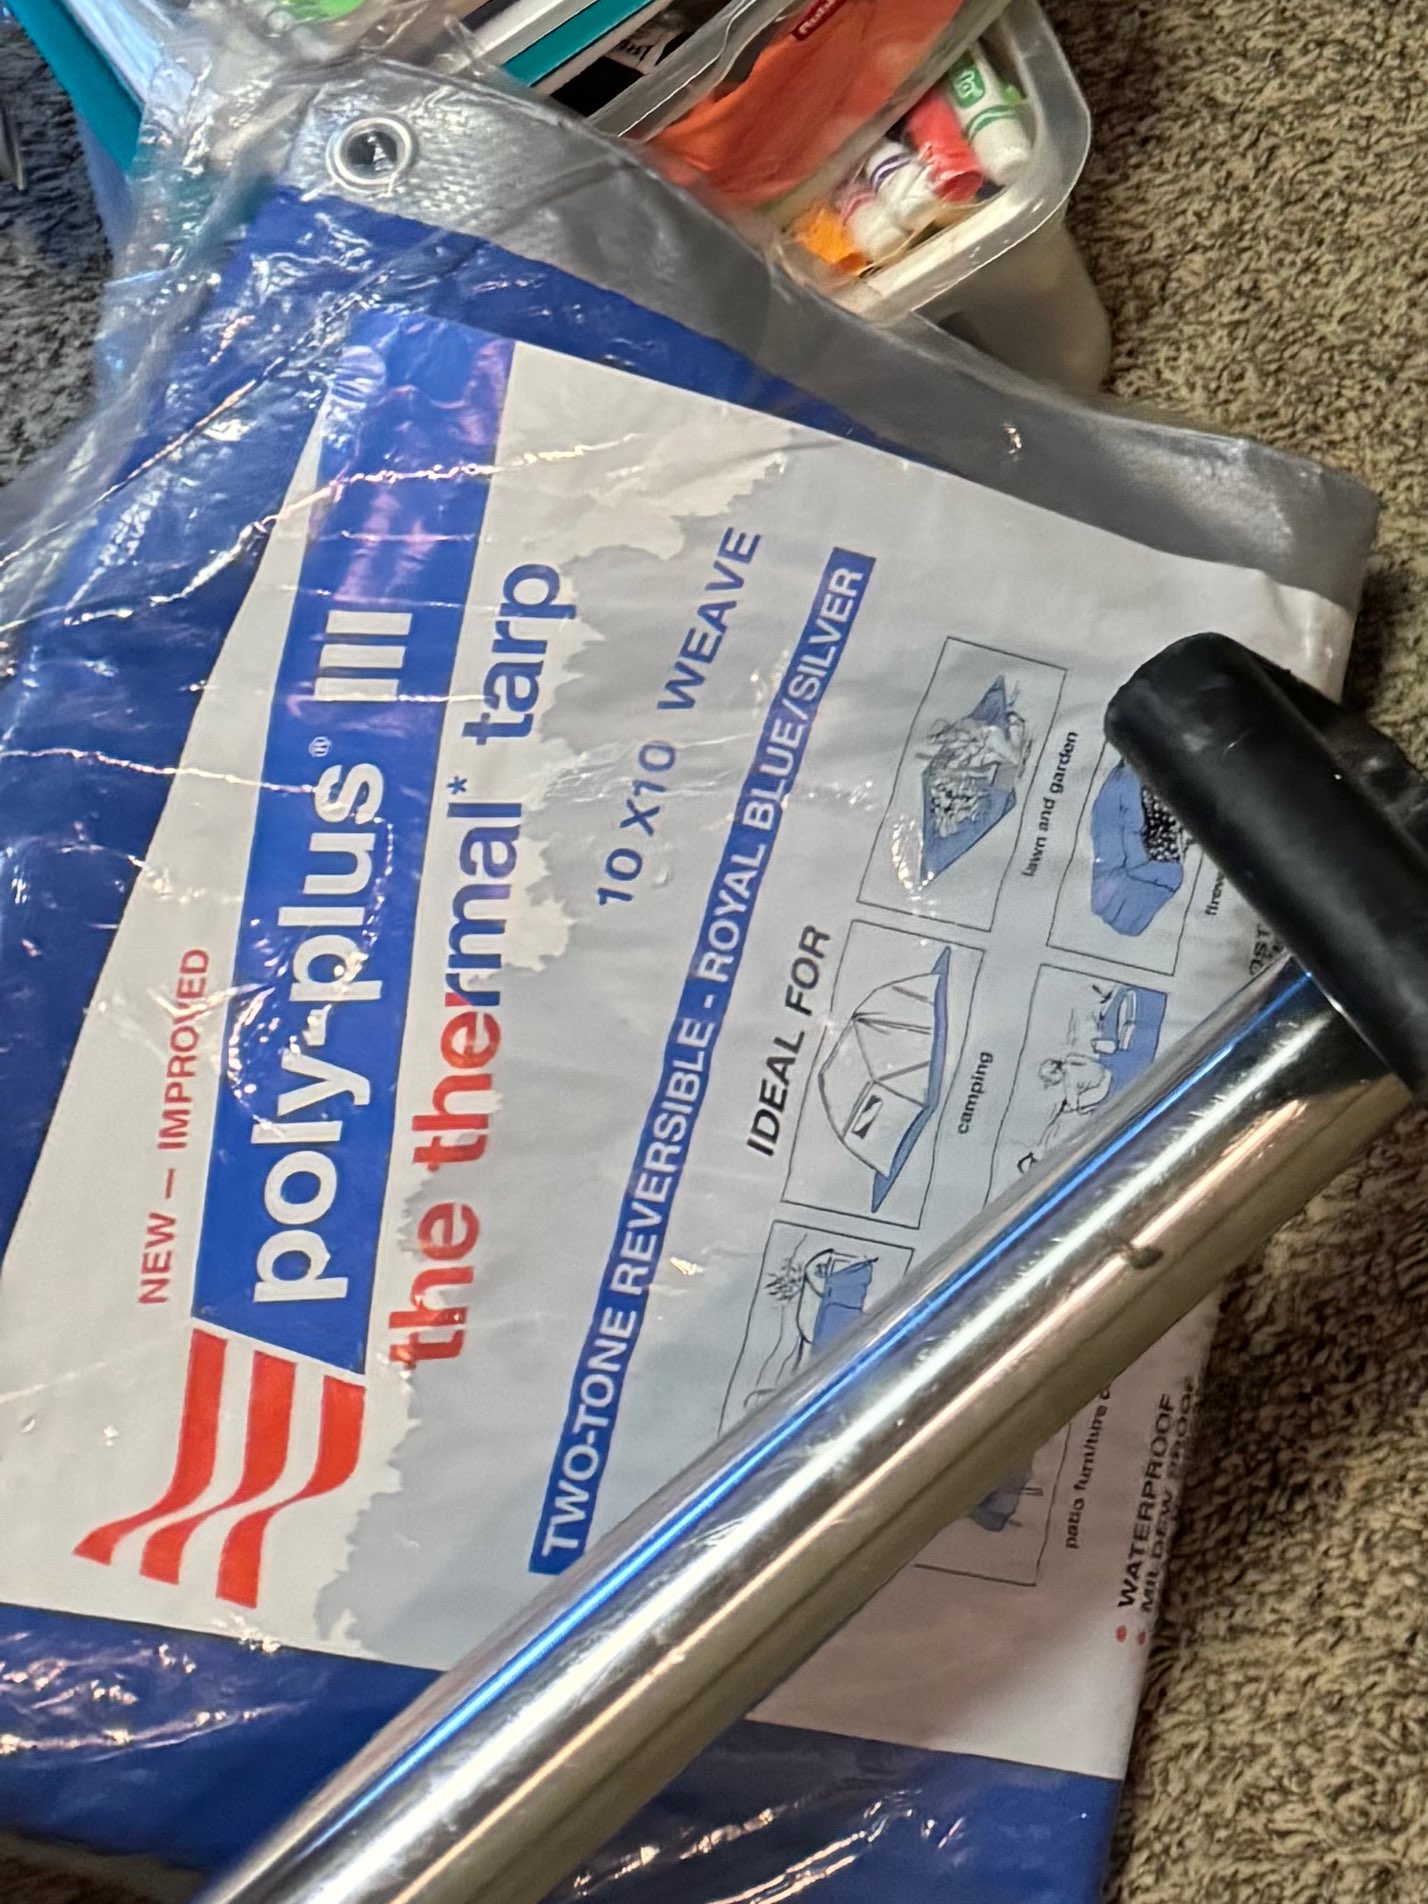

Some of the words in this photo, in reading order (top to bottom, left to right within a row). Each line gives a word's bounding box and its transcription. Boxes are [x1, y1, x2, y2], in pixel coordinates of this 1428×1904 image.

[597, 847, 644, 905] 10
[656, 527, 761, 710] WEAVE
[1021, 831, 1048, 879] lawn
[1036, 796, 1056, 830] and
[1049, 730, 1079, 796] garden
[157, 949, 210, 1151] IMPROVED
[388, 1202, 482, 1370] the
[462, 562, 577, 745] tarp
[542, 1306, 636, 1558] TWO-TONE
[610, 1018, 713, 1295] REVERSIBLE
[699, 842, 766, 983] ROYAL
[742, 566, 864, 831] BLUE/SILVER
[746, 1027, 806, 1157] IDEAL
[785, 924, 831, 1014] FOR
[957, 1050, 994, 1135] camping
[138, 1211, 180, 1304] NEW
[1066, 1497, 1085, 1550] patio
[1073, 1405, 1108, 1492] furniture
[1117, 1393, 1176, 1609] WATERPROOF
